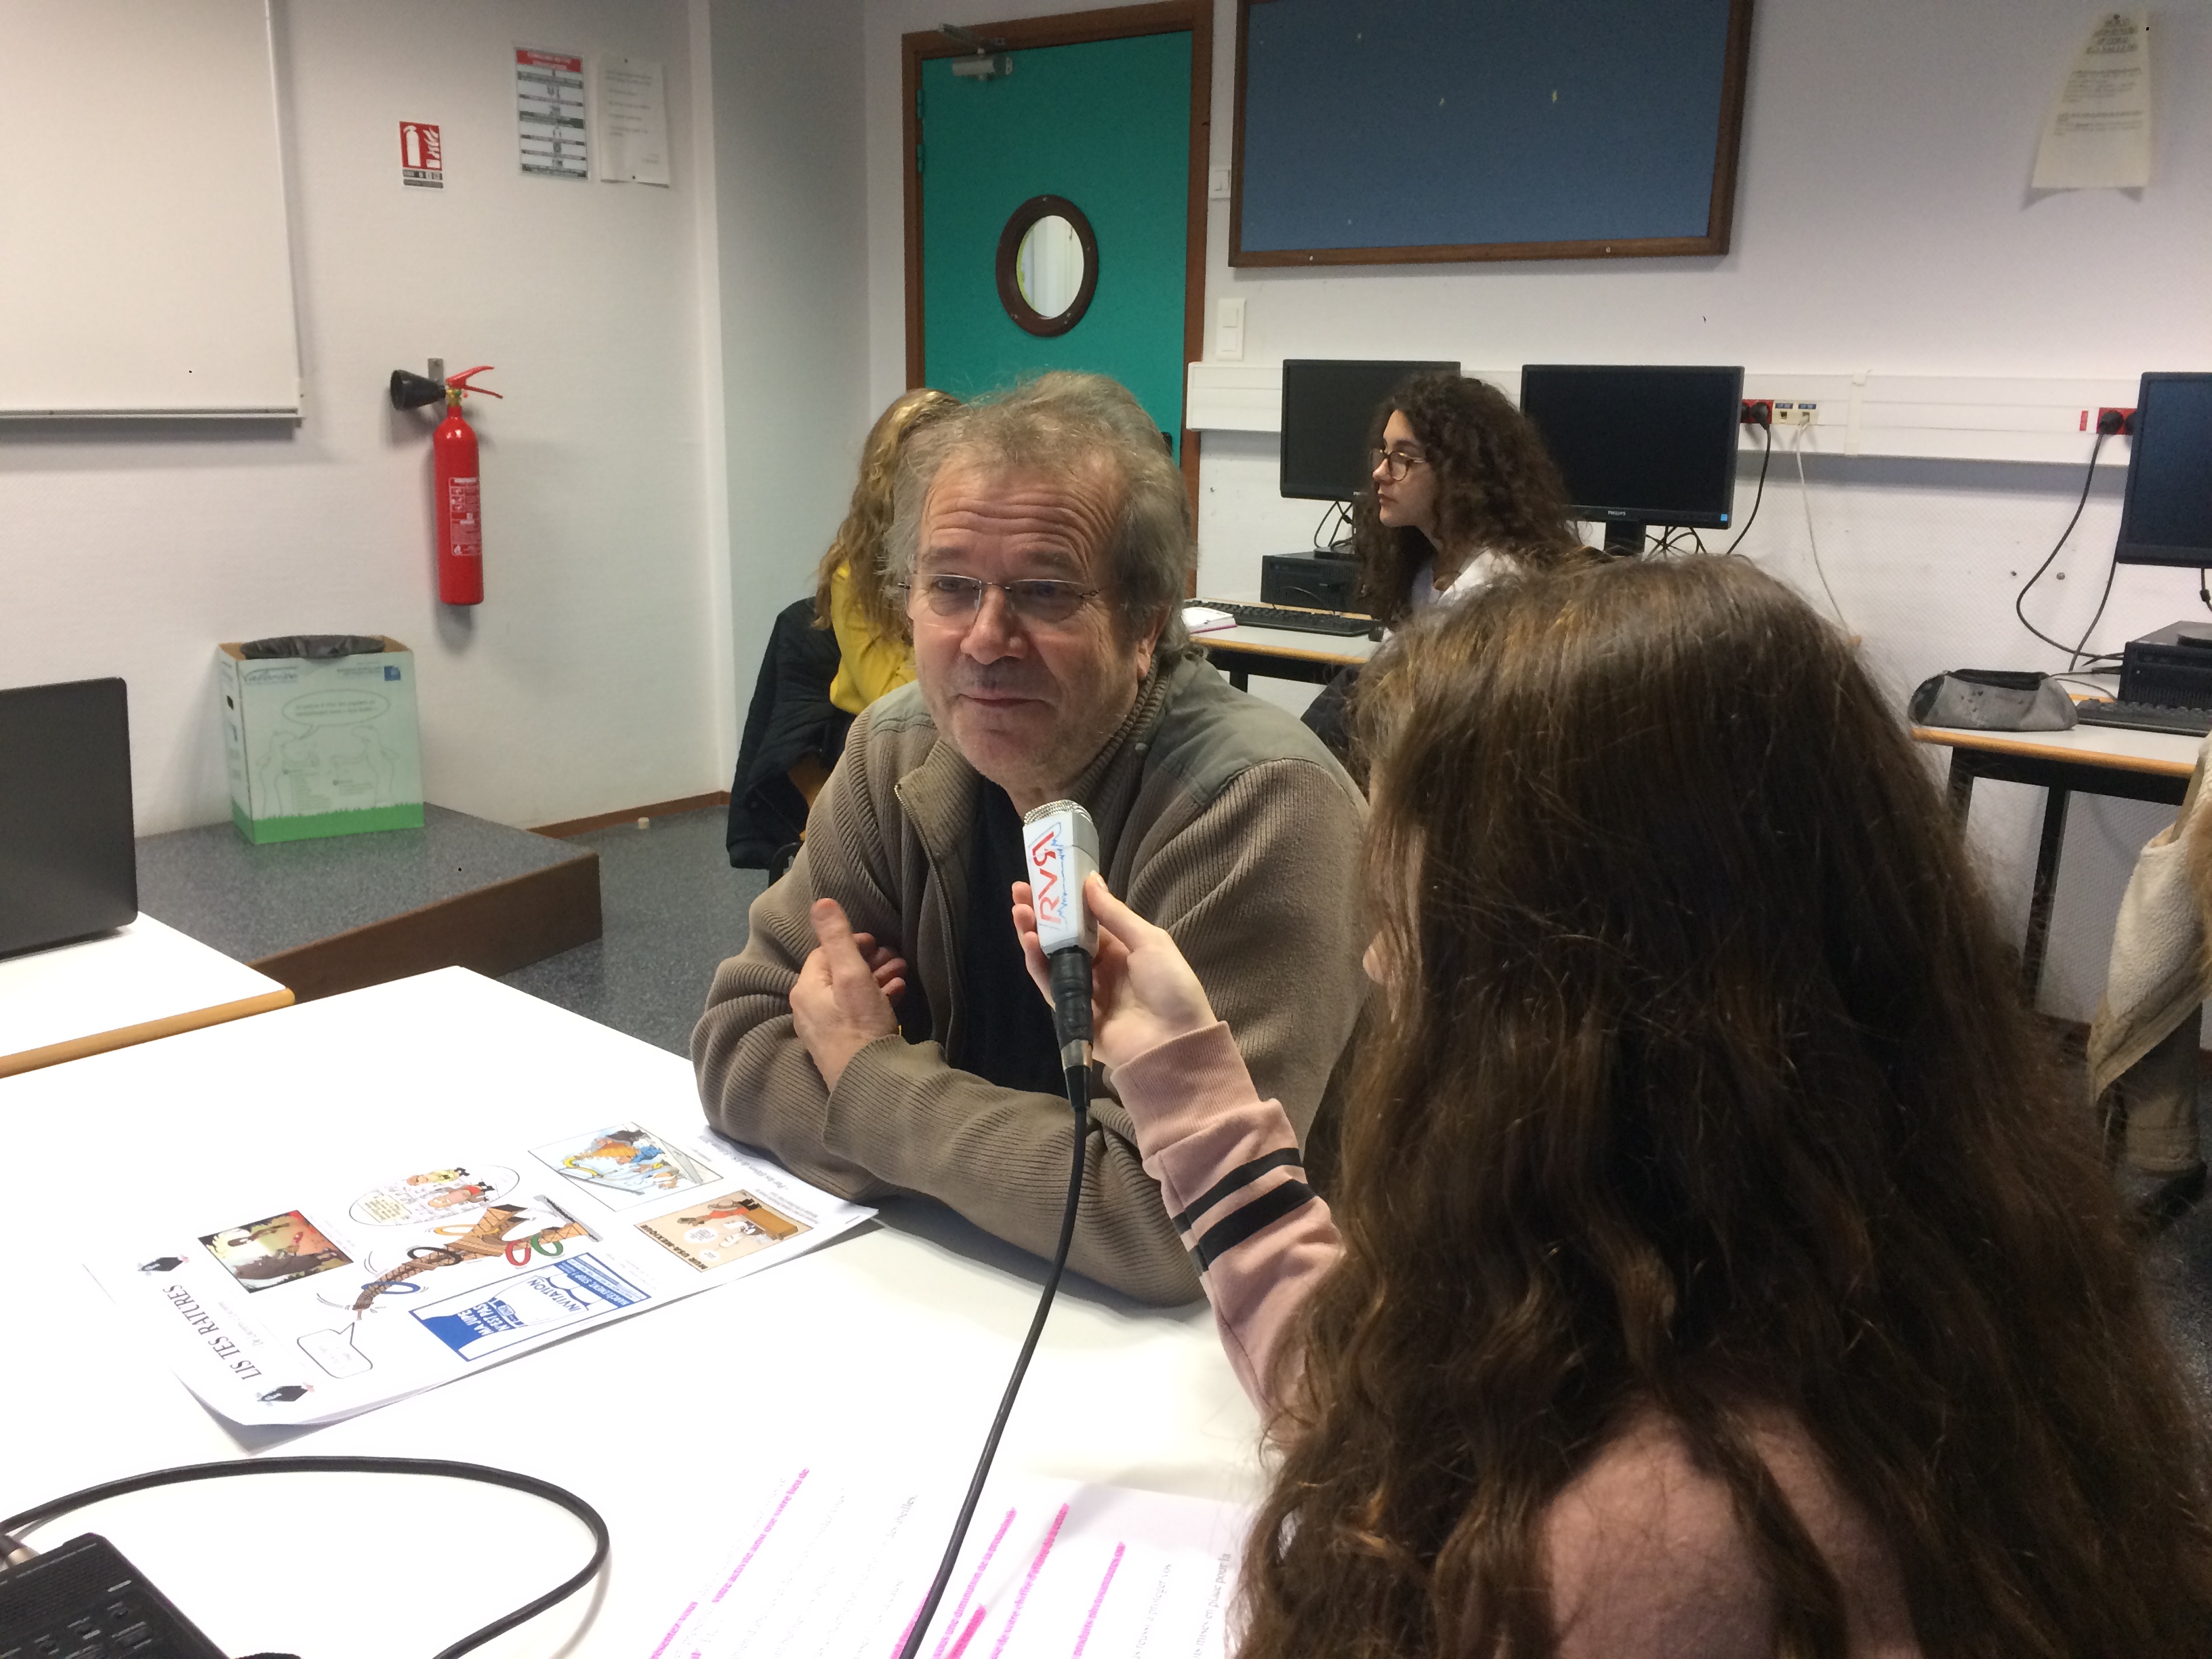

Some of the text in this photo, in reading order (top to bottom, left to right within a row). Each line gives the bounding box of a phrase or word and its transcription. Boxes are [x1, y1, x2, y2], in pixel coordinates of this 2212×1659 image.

[639, 1224, 690, 1258] USA-MEXIQUE
[688, 1257, 708, 1269] MUR
[527, 1279, 581, 1311] INVITATION
[457, 1310, 494, 1336] MA JUPE
[474, 1303, 510, 1331] N'EST PAS
[163, 1284, 262, 1380] LIS TES RATURES
[712, 1581, 731, 1605] votre
[751, 1532, 766, 1551] ainsi
[764, 1517, 777, 1533] que
[773, 1494, 791, 1517] votre
[786, 1477, 802, 1496] lieu
[798, 1467, 809, 1479] de
[1162, 1563, 1172, 1577] vos
[1217, 1553, 1231, 1561] la
[934, 1509, 1015, 1656] vous une diminution de la production
[1214, 1564, 1229, 1584] pour
[1071, 1544, 1125, 1656] produits phytosanitaires ou
[1206, 1585, 1223, 1607] place
[679, 1599, 698, 1622] vous
[996, 1633, 1009, 1645] de
[1005, 1610, 1021, 1633] votre
[1014, 1580, 1033, 1608] chiffre
[1205, 1609, 1213, 1618] en
[1196, 1621, 1209, 1645] mises
